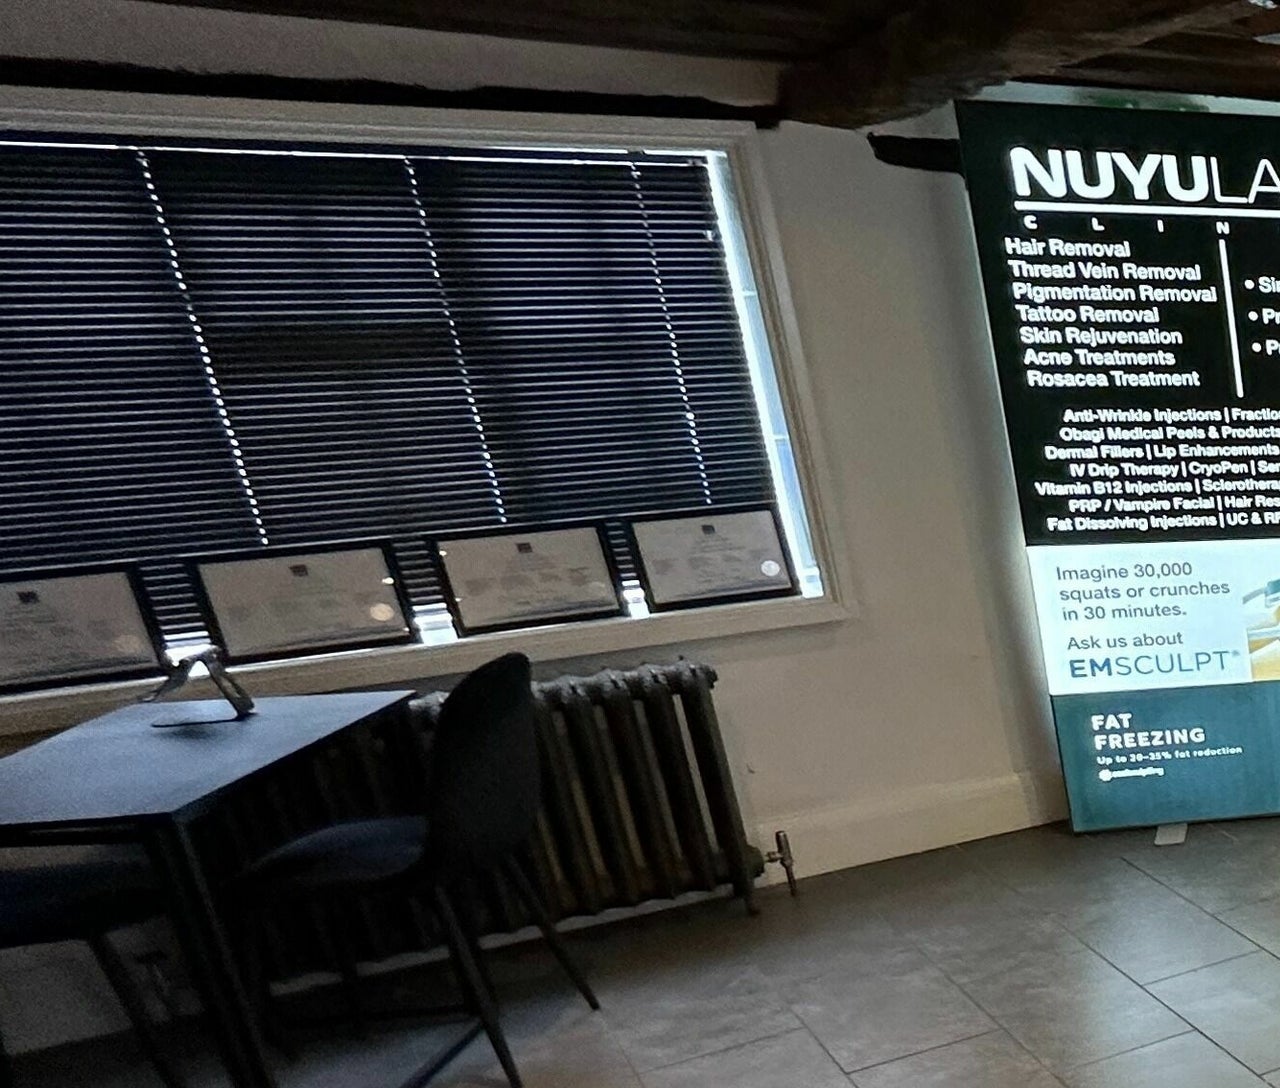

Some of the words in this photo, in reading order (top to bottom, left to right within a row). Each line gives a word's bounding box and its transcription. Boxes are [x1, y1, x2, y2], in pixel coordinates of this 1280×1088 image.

[1005, 237, 1046, 256] Hair
[1048, 238, 1131, 258] Removal
[1008, 259, 1076, 278] Thread
[1078, 261, 1119, 280] Vein
[1122, 262, 1201, 281] Removal
[1012, 282, 1136, 303] Pigmentation
[1139, 284, 1218, 303] Removal
[1015, 304, 1076, 323] Tattoo
[1079, 305, 1160, 323] Removal
[1019, 326, 1062, 344] Skin
[1065, 327, 1183, 348] Rejuvenation
[1024, 348, 1073, 366] Acne
[1074, 348, 1176, 366] Treatments
[1026, 370, 1109, 387] Rosacea
[1109, 371, 1200, 387] Treatment
[1063, 408, 1152, 423] Anti-Wrinkle
[1153, 408, 1222, 424] Injections
[1059, 427, 1105, 443] Obagi
[1106, 427, 1164, 440] Medical
[1165, 426, 1205, 440] Peels
[1207, 426, 1220, 439] &
[1044, 445, 1098, 460] Dermal
[1101, 445, 1144, 459] Fillers
[1153, 444, 1176, 459] Lip
[1178, 443, 1280, 457] Enhancements
[1069, 463, 1085, 477] IV
[1087, 463, 1119, 479] Drip
[1120, 462, 1179, 478] Therapy
[1188, 461, 1248, 477] CryoPen
[1034, 481, 1091, 496] Vitamin
[1093, 481, 1123, 495] B12
[1125, 480, 1193, 496] Injections
[1068, 499, 1101, 512] PRP
[1113, 498, 1171, 513] Vampire
[1173, 496, 1215, 510] Facial
[1224, 496, 1253, 508] Hair
[1046, 517, 1074, 531] Fat
[1074, 516, 1148, 531] Dissolving
[1150, 515, 1217, 530] Injections
[1251, 512, 1262, 525] &
[1056, 565, 1129, 583] Imagine
[1133, 562, 1192, 579] 30,000
[1059, 586, 1121, 603] squats
[1126, 586, 1144, 598] or
[1149, 581, 1231, 598] crunches
[1062, 607, 1079, 621] in
[1084, 606, 1106, 620] 30
[1111, 604, 1187, 619] minutes.
[1067, 636, 1101, 650] Ask
[1107, 636, 1128, 648] us
[1133, 631, 1184, 646] about
[1091, 713, 1132, 731] FAT
[1094, 728, 1206, 750] FREEZING
[1096, 755, 1113, 765] Up
[1116, 755, 1127, 763] to
[1174, 749, 1191, 759] fat
[1193, 746, 1243, 757] reduction
